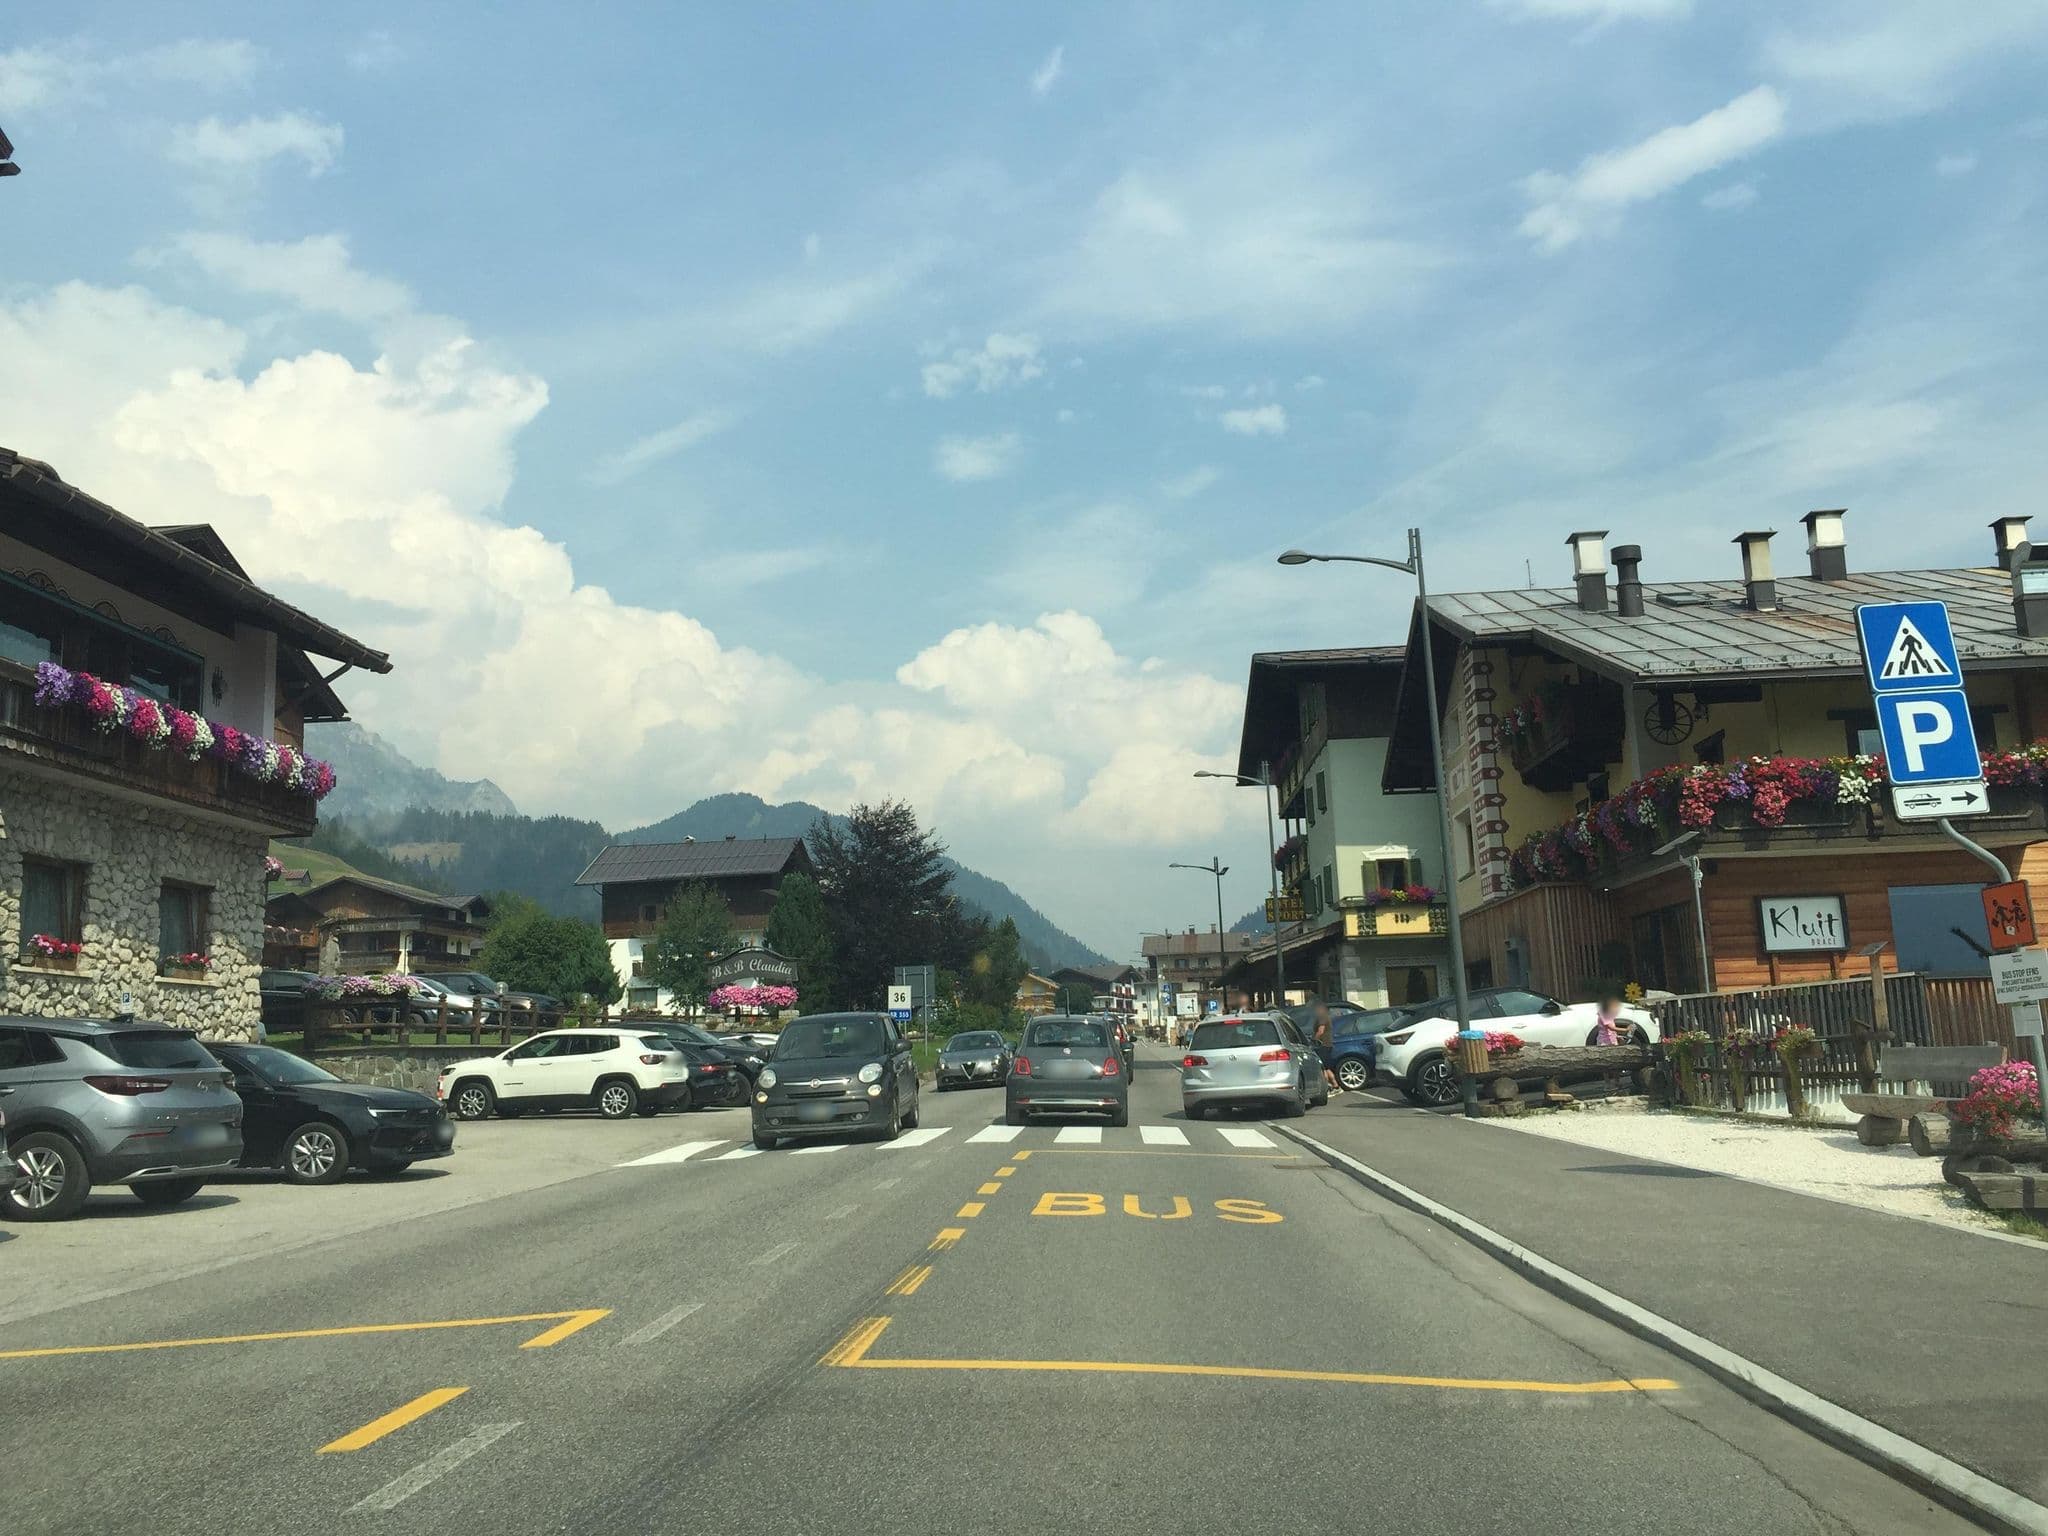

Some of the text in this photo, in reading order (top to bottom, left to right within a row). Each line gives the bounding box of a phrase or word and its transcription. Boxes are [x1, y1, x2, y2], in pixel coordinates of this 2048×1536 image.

[1896, 701, 1953, 772] P
[1267, 898, 1303, 909] HTEL
[1769, 905, 1840, 938] Kluit
[750, 958, 793, 975] Claudia
[894, 992, 906, 1003] 36
[1030, 1192, 1284, 1223] BUS
